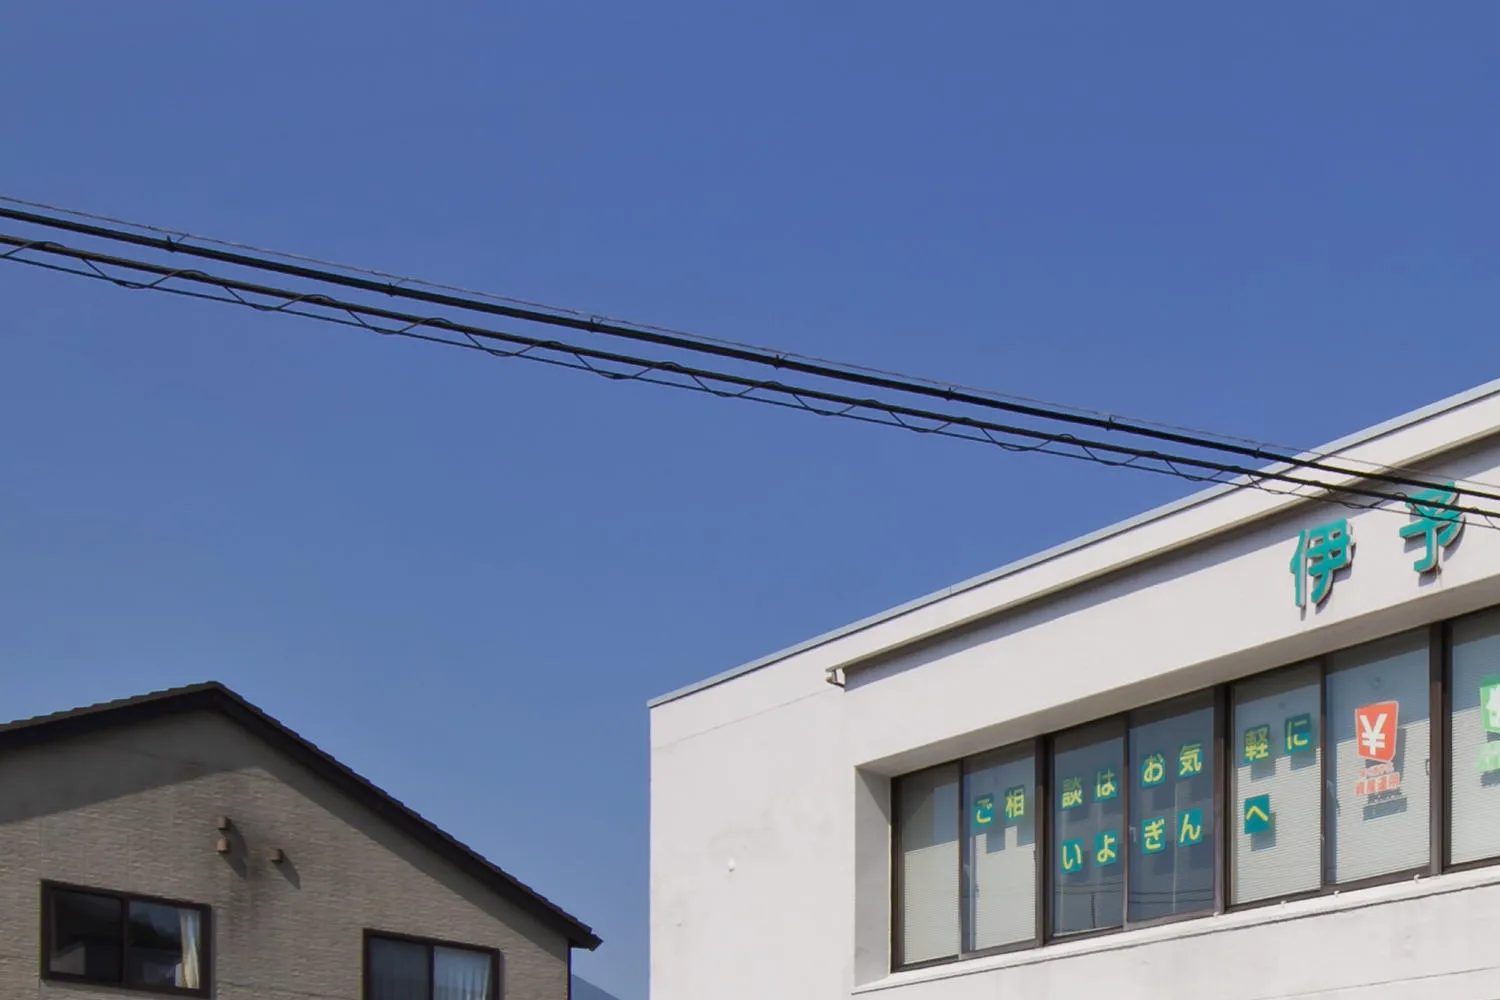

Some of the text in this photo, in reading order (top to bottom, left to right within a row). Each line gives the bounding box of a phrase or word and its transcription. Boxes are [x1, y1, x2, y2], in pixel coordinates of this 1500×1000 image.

[976, 719, 1309, 824] ご相談はお気軽に
